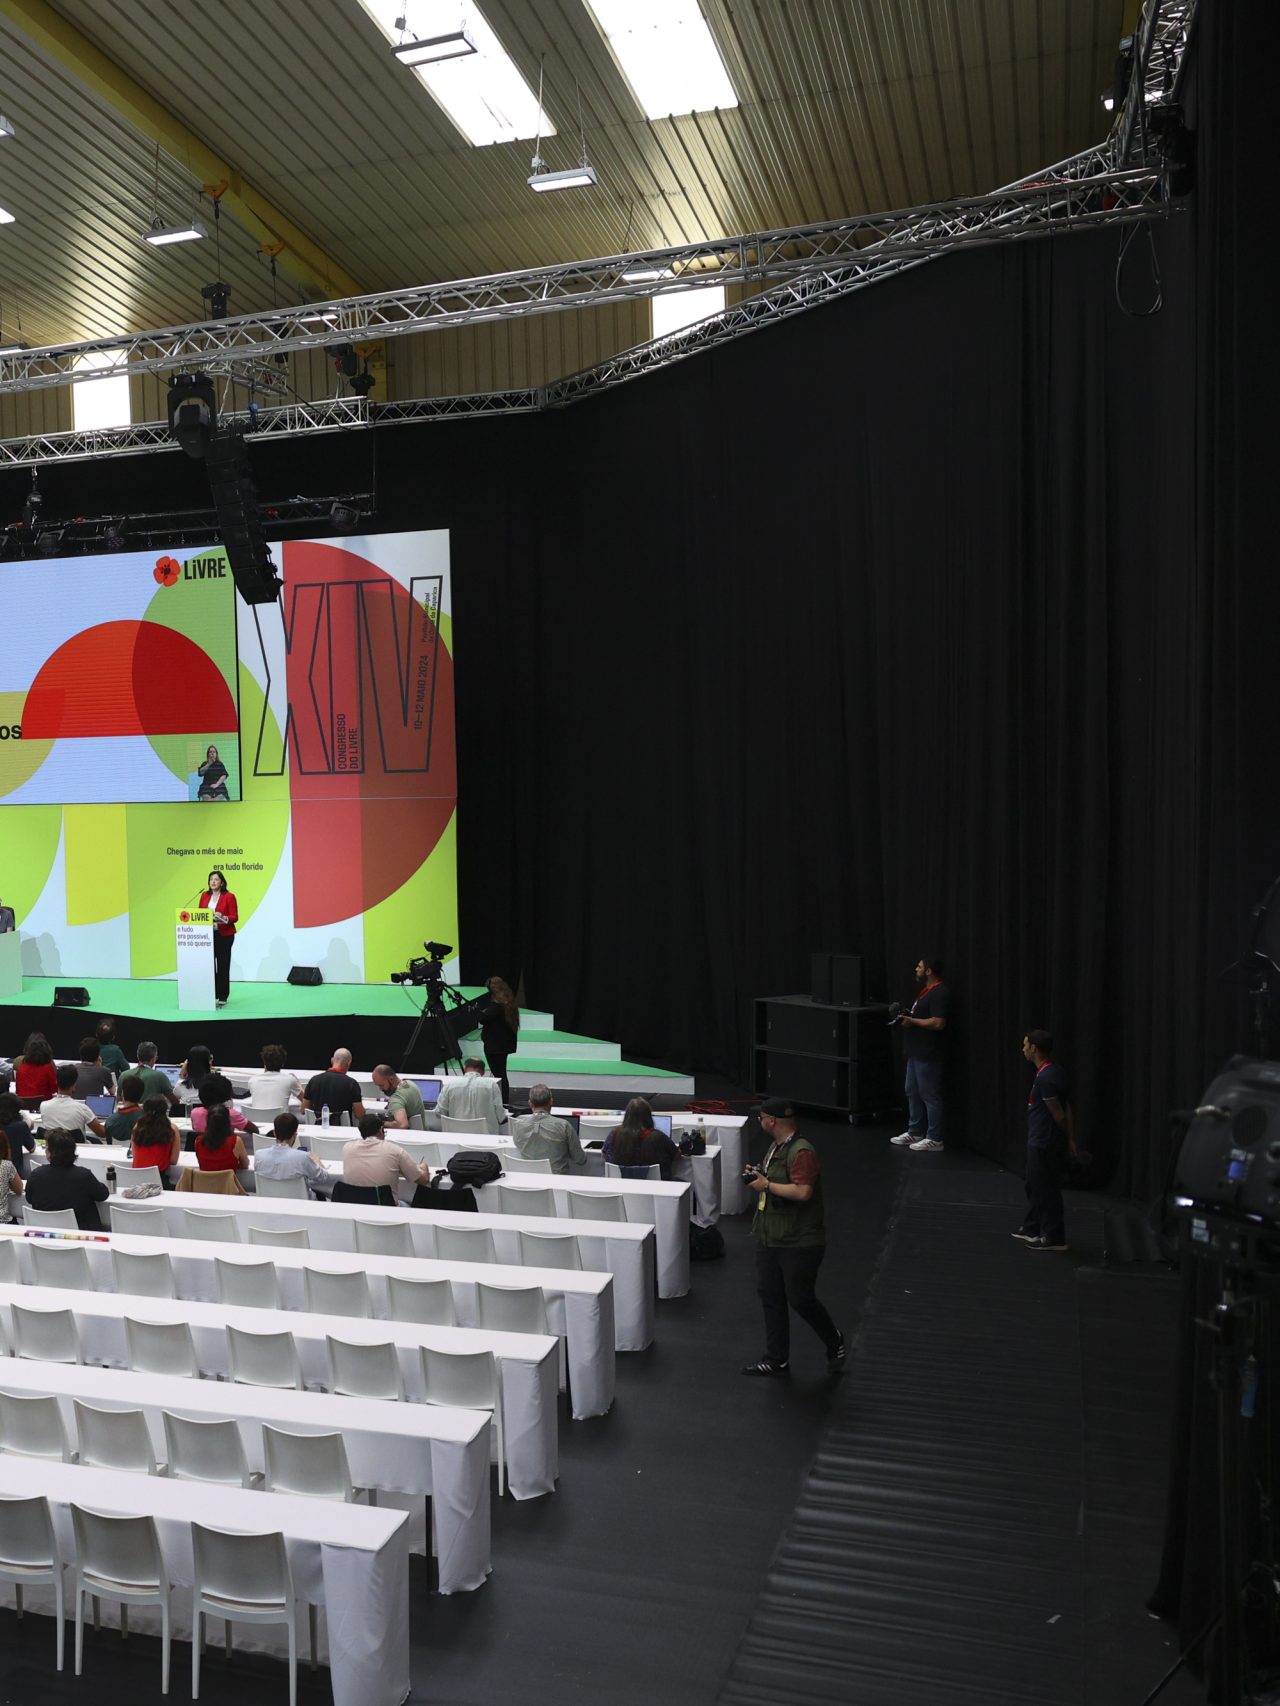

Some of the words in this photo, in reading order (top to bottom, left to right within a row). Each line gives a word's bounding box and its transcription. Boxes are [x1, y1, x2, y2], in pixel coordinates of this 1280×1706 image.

[184, 557, 227, 581] LiVRE
[418, 655, 429, 678] 2024
[336, 713, 347, 769] CONGRESSO
[348, 727, 359, 754] LIVRE
[349, 756, 359, 769] DO
[166, 847, 195, 856] Chegava
[201, 847, 216, 855] mês
[217, 847, 226, 855] de
[227, 847, 244, 855] maio
[225, 862, 241, 870] tudo
[241, 862, 264, 870] florido
[191, 913, 209, 922] LiVRE
